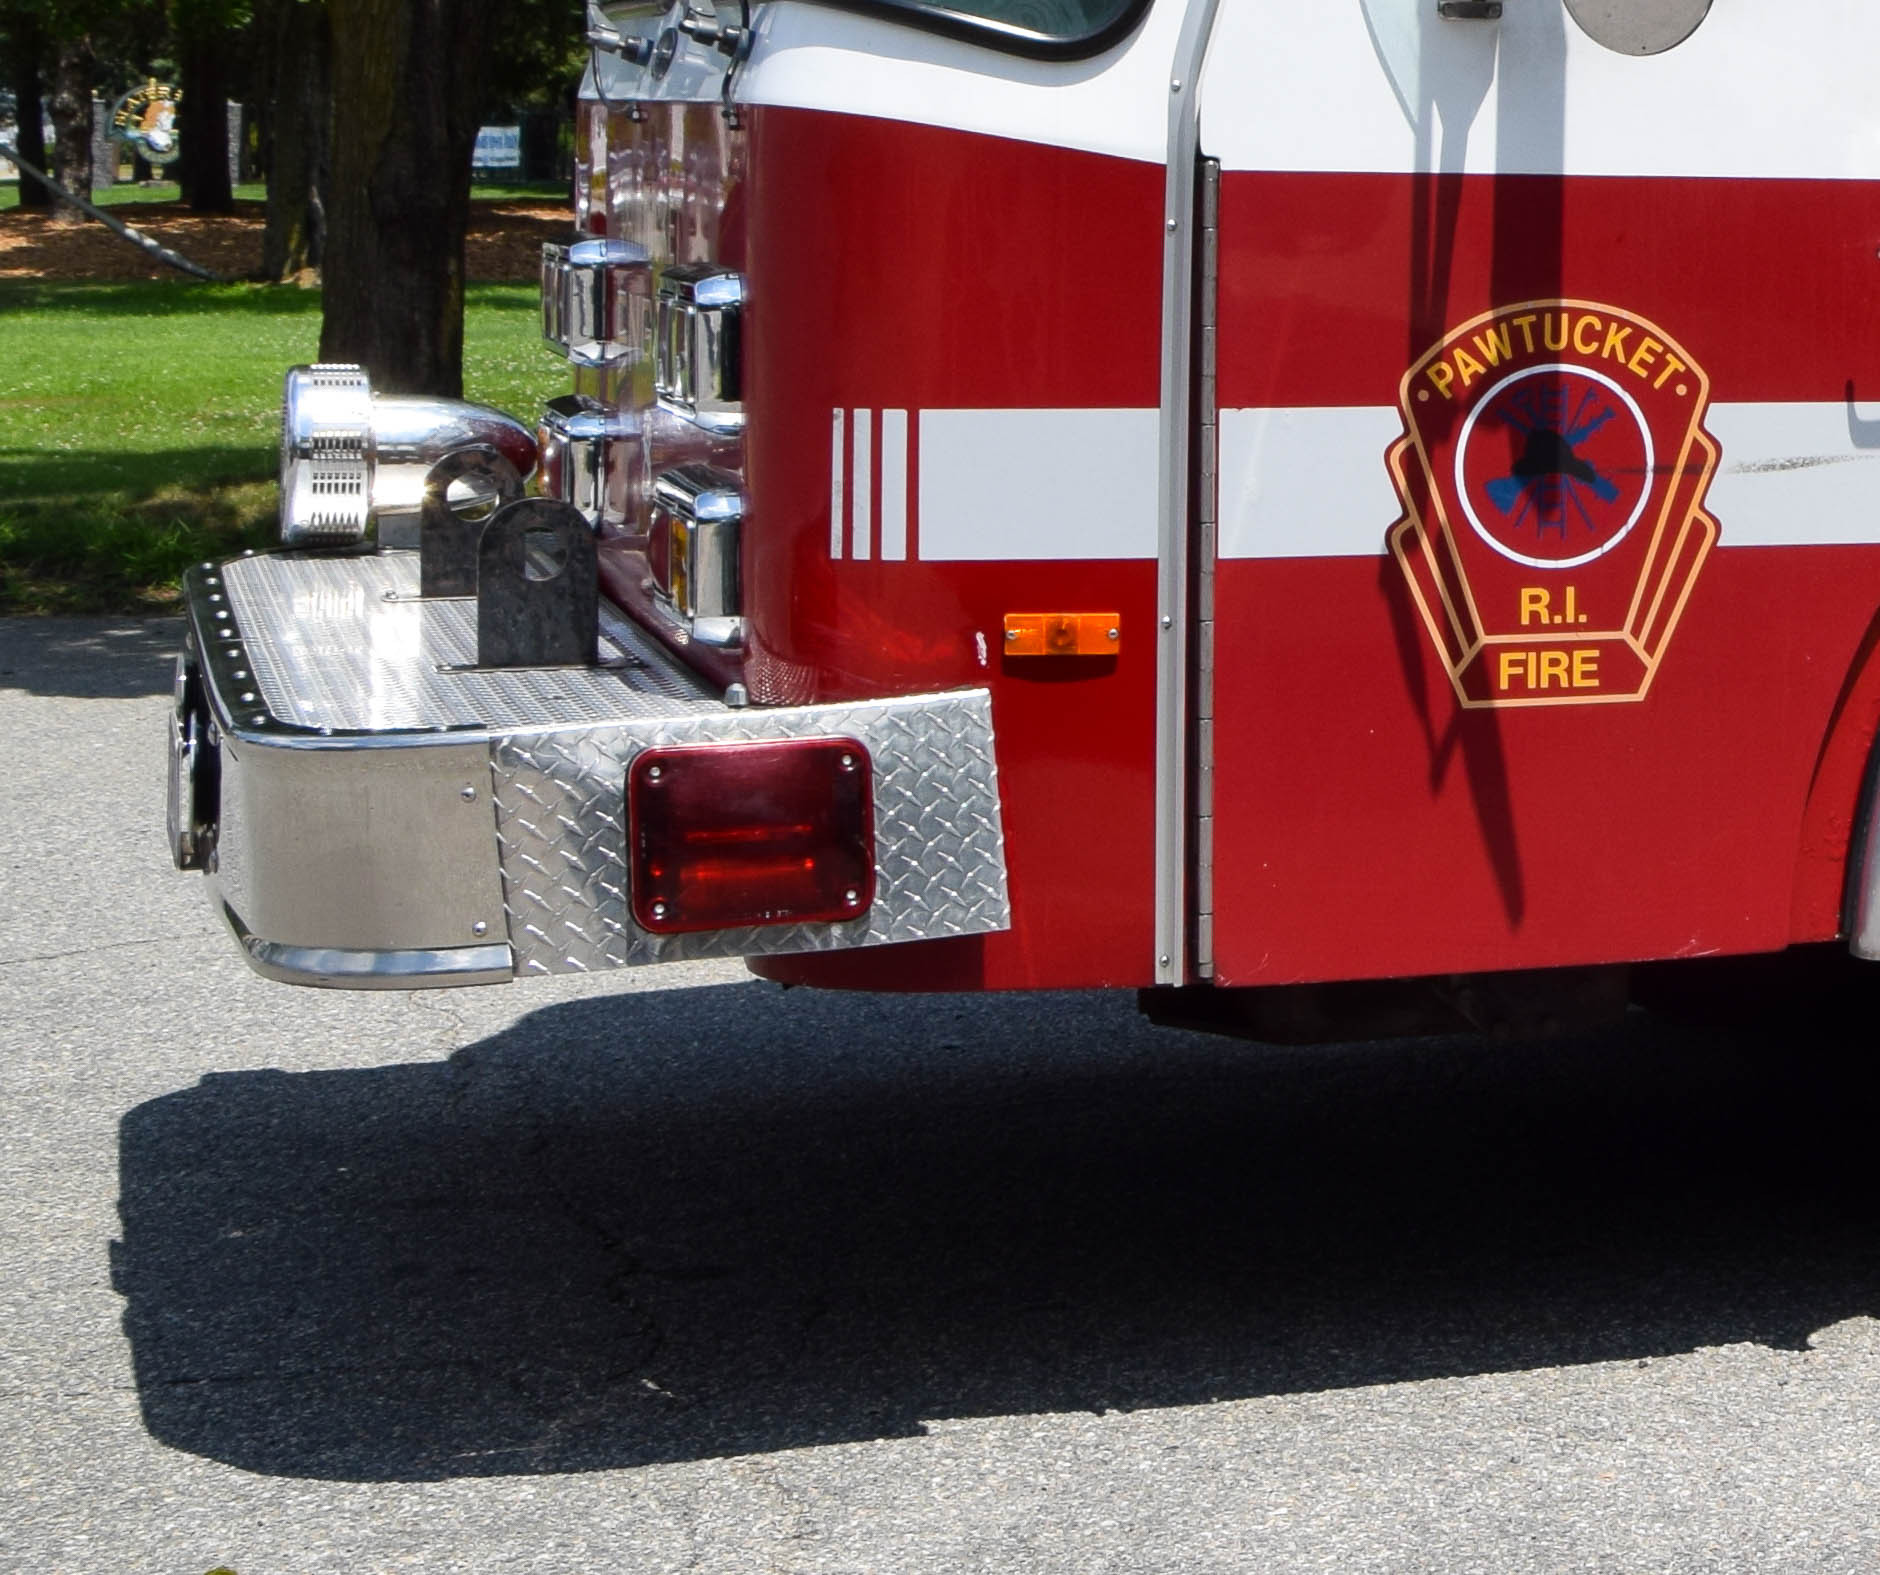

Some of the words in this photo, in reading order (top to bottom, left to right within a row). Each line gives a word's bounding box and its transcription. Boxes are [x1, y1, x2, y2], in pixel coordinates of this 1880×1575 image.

[1426, 312, 1687, 401] PAWTUCKET
[1520, 586, 1587, 627] R.I.
[1498, 649, 1601, 692] FIRE
